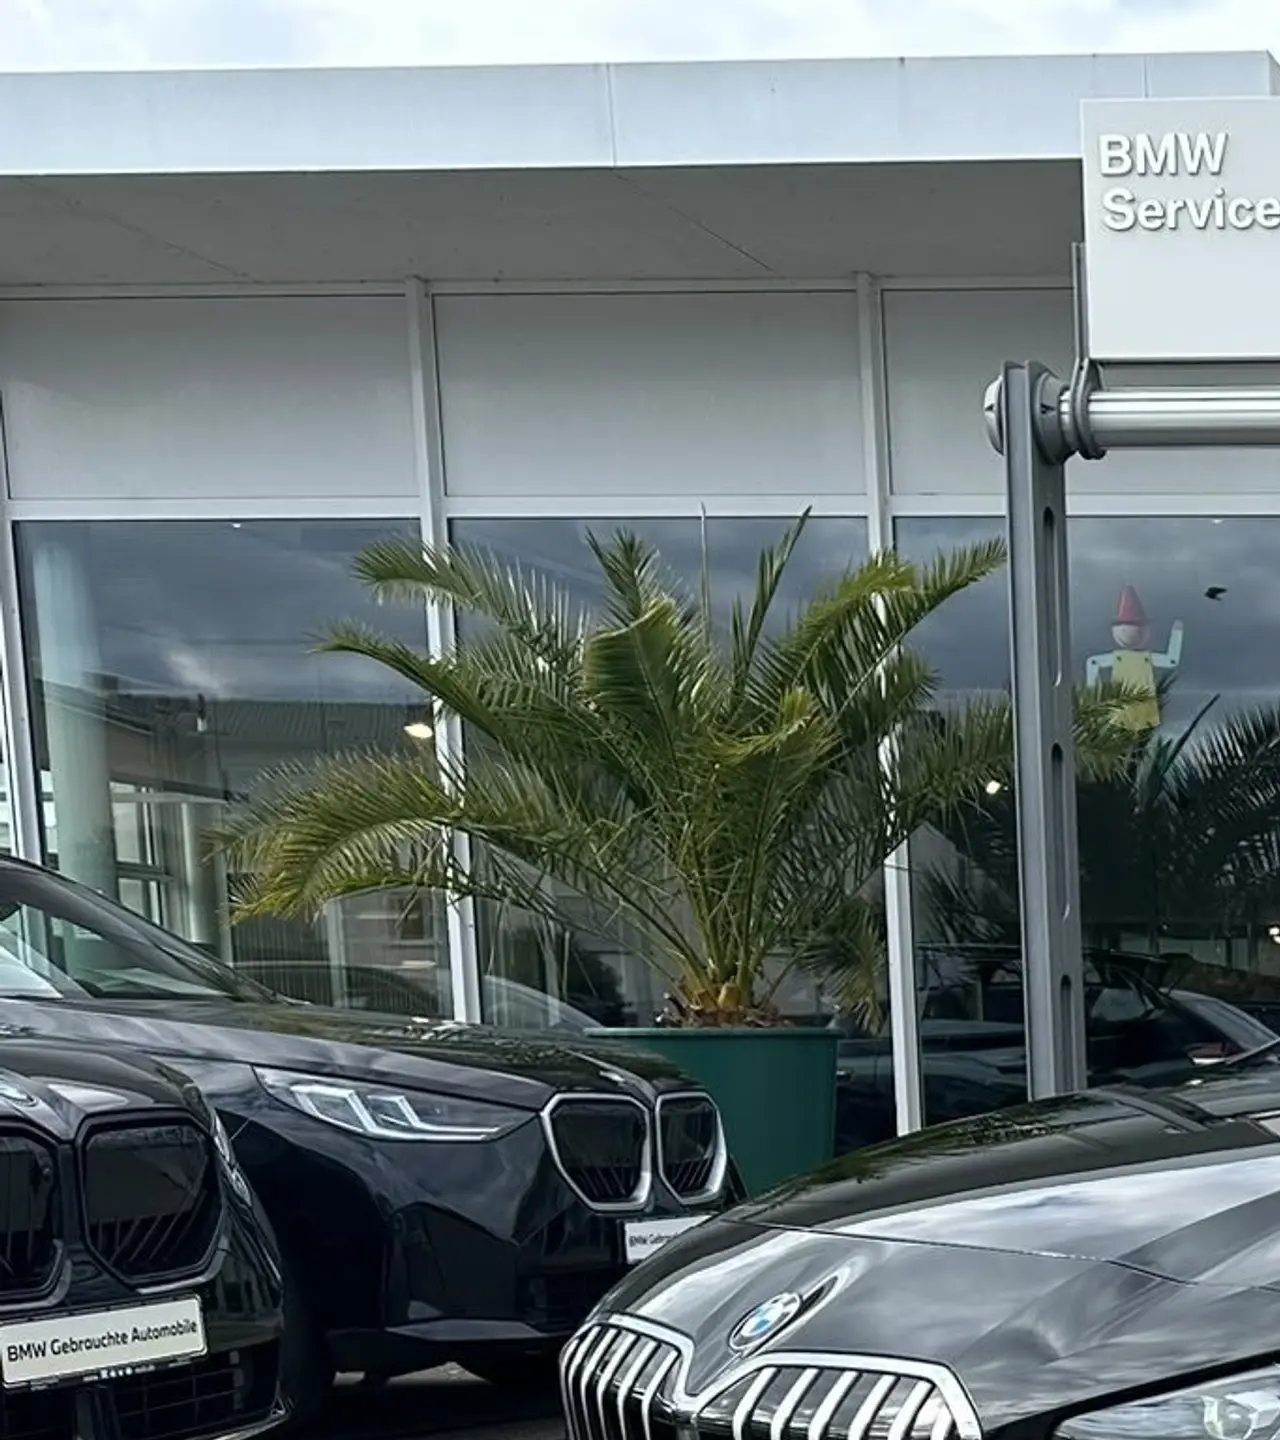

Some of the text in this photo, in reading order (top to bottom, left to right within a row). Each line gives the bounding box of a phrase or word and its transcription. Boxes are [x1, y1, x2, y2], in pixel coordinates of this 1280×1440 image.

[1099, 132, 1229, 177] BMW
[7, 1318, 198, 1362] BMW Gebrauchte Automobile
